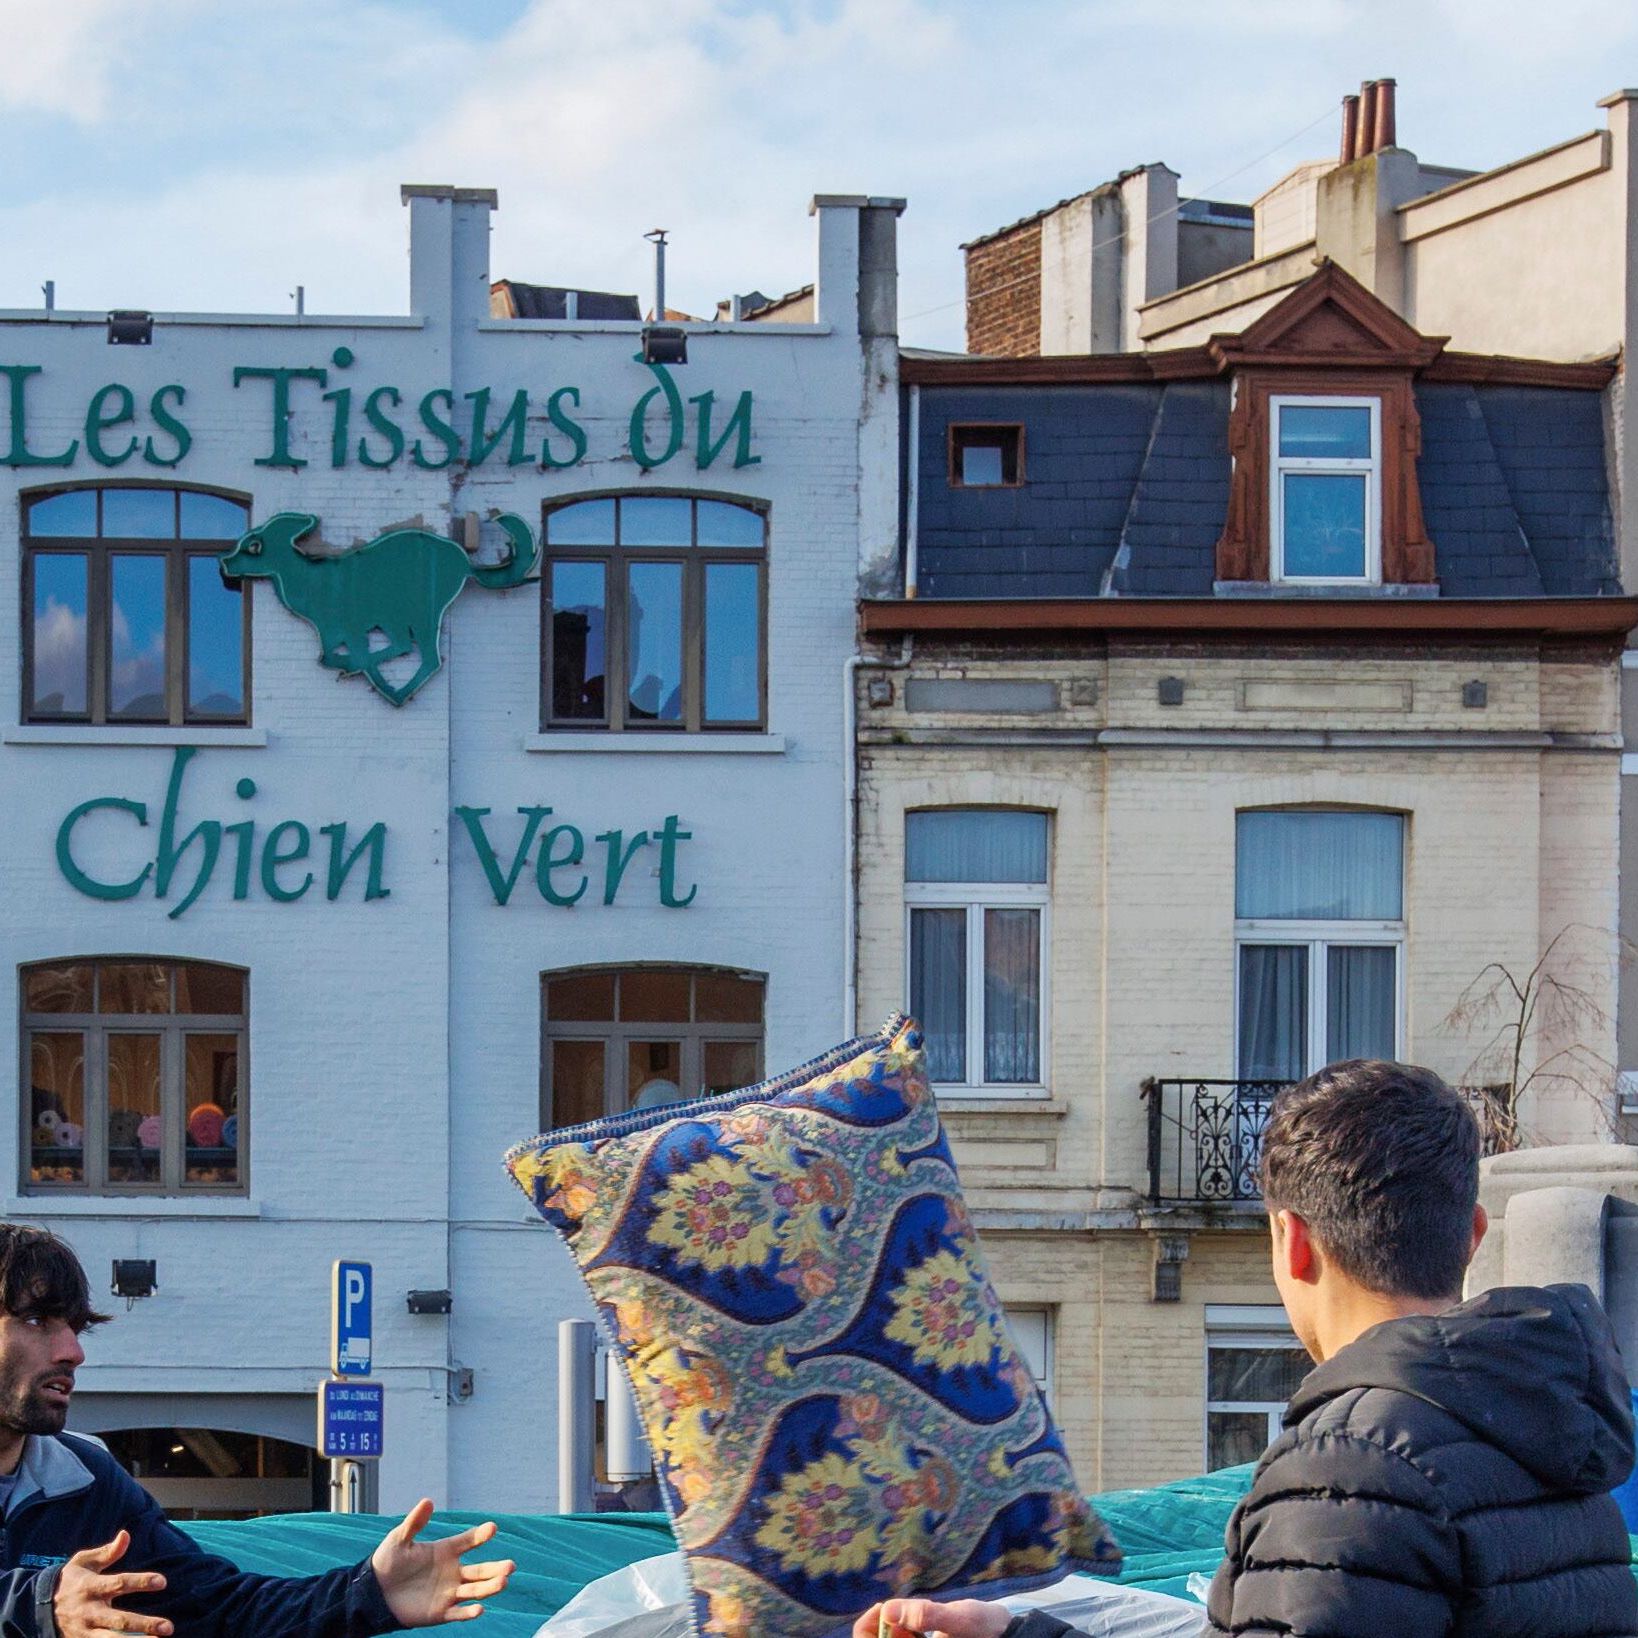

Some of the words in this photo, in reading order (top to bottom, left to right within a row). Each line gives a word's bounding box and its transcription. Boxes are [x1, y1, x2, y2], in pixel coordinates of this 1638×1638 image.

[233, 346, 589, 468] Tissus
[628, 350, 762, 468] du
[54, 747, 391, 919] Chien
[452, 804, 698, 909] Vert
[345, 1269, 365, 1328] P
[340, 1433, 347, 1450] 5
[360, 1433, 370, 1450] 15
